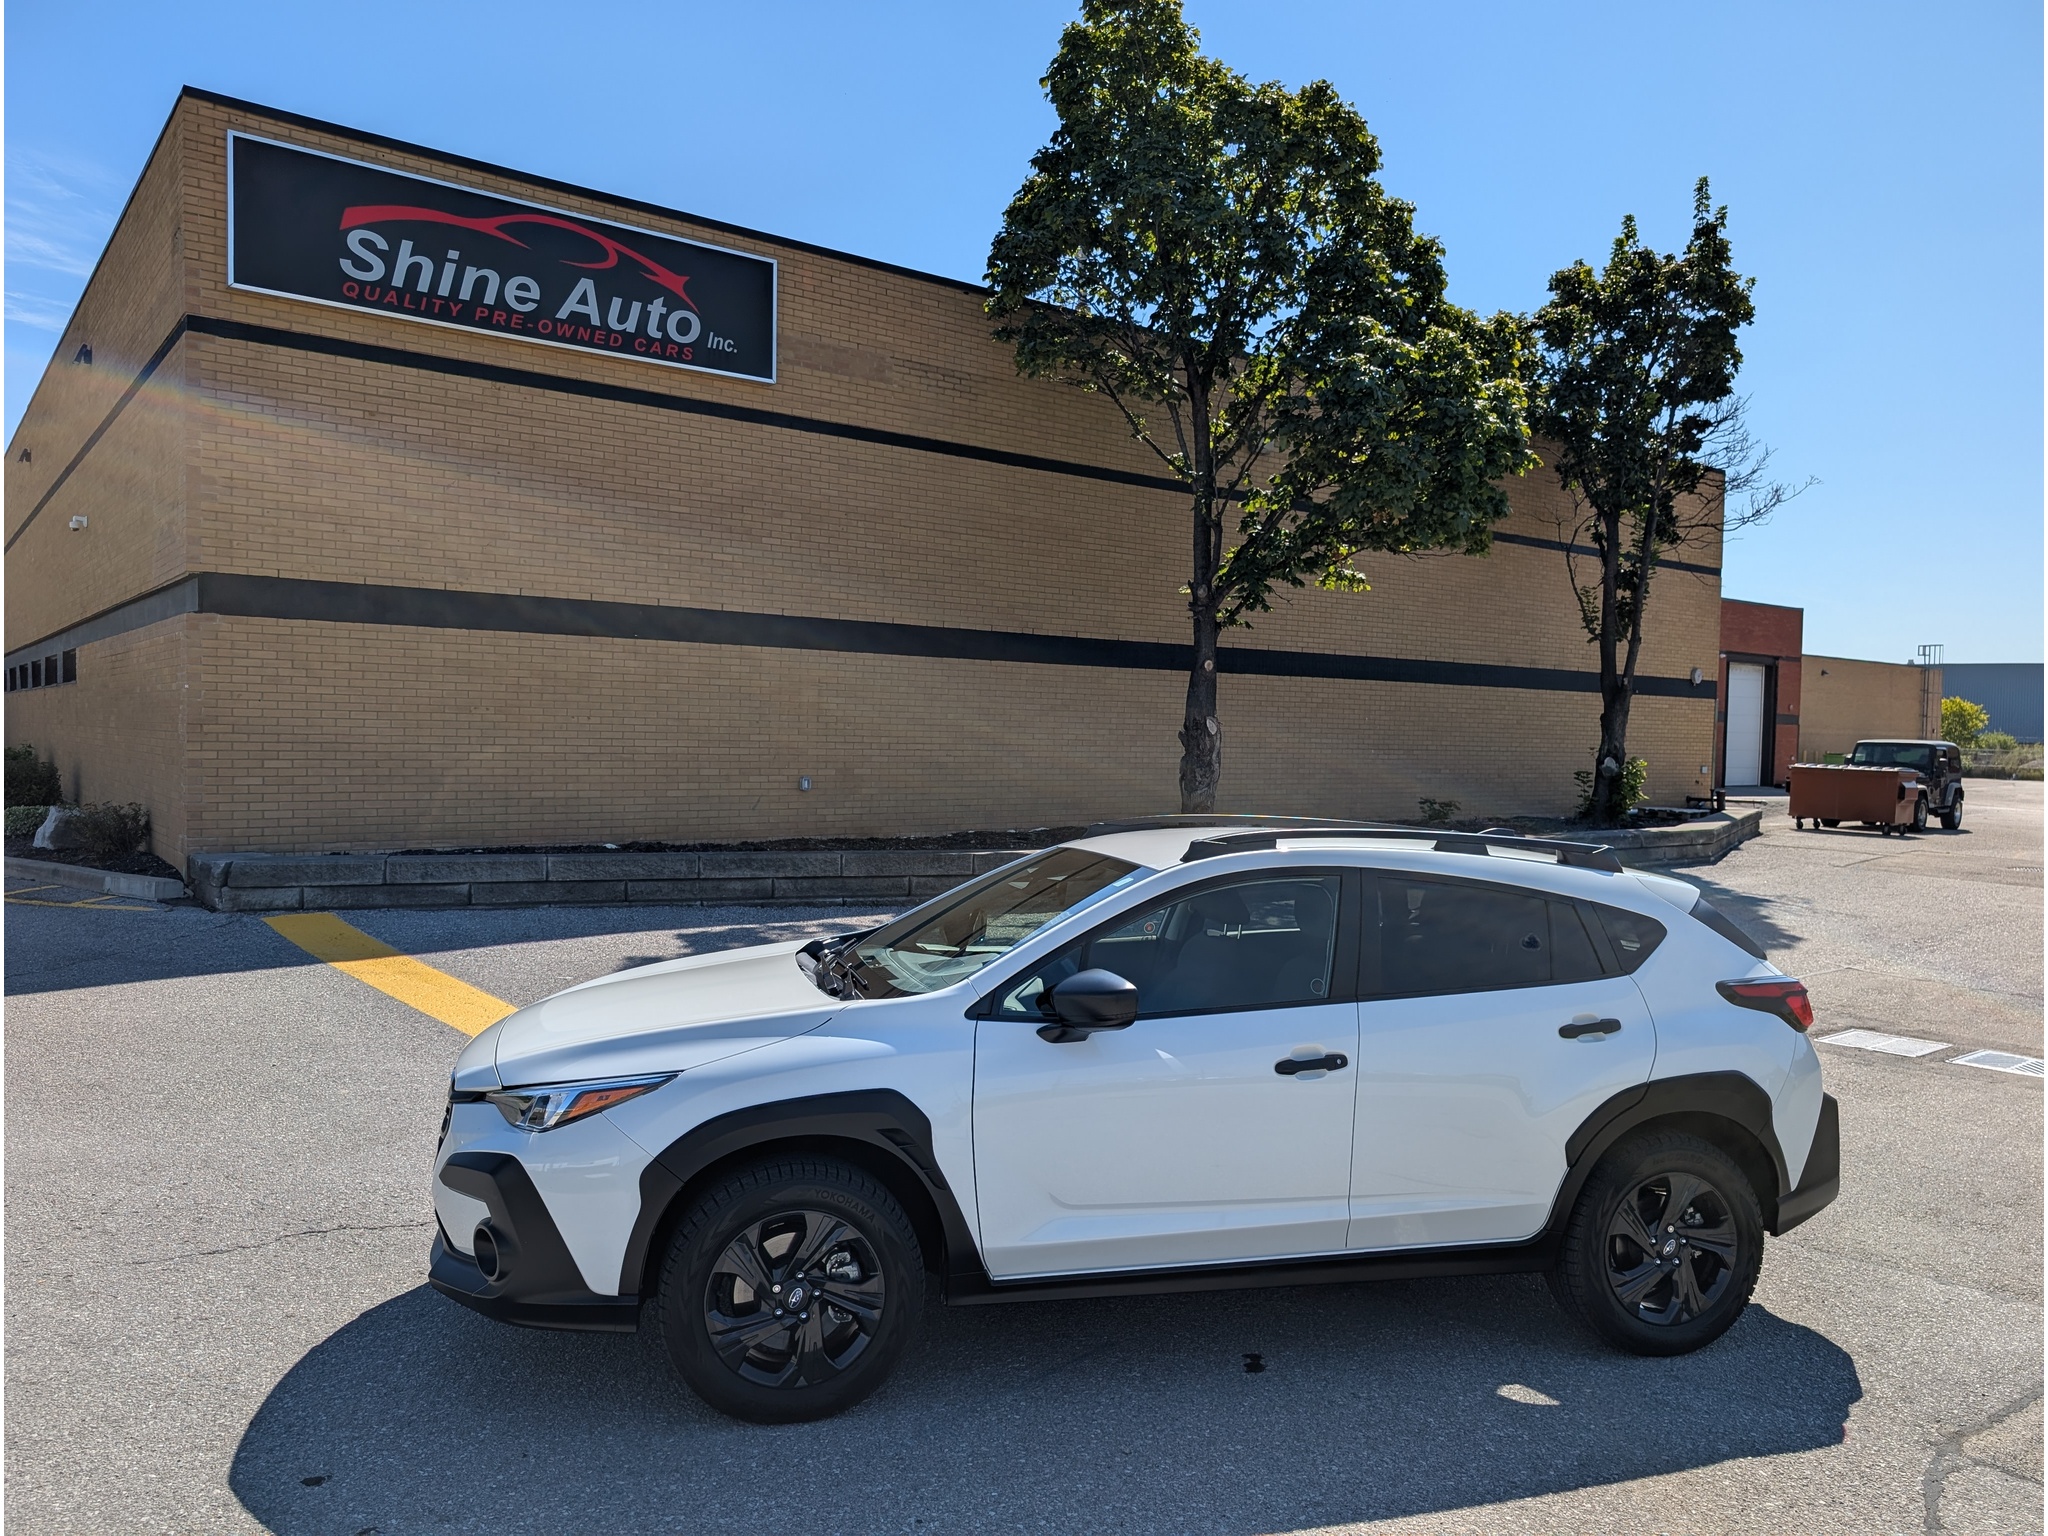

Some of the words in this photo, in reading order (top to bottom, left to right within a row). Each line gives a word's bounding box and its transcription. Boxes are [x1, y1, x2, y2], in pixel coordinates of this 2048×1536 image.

[340, 229, 541, 312] Shine
[555, 277, 701, 344] Auto
[707, 332, 738, 354] Inc.
[342, 282, 463, 317] QUALITY
[475, 307, 623, 347] PRE-OWNED
[634, 338, 693, 360] CARS
[815, 1189, 875, 1223] YOKOHAMA
